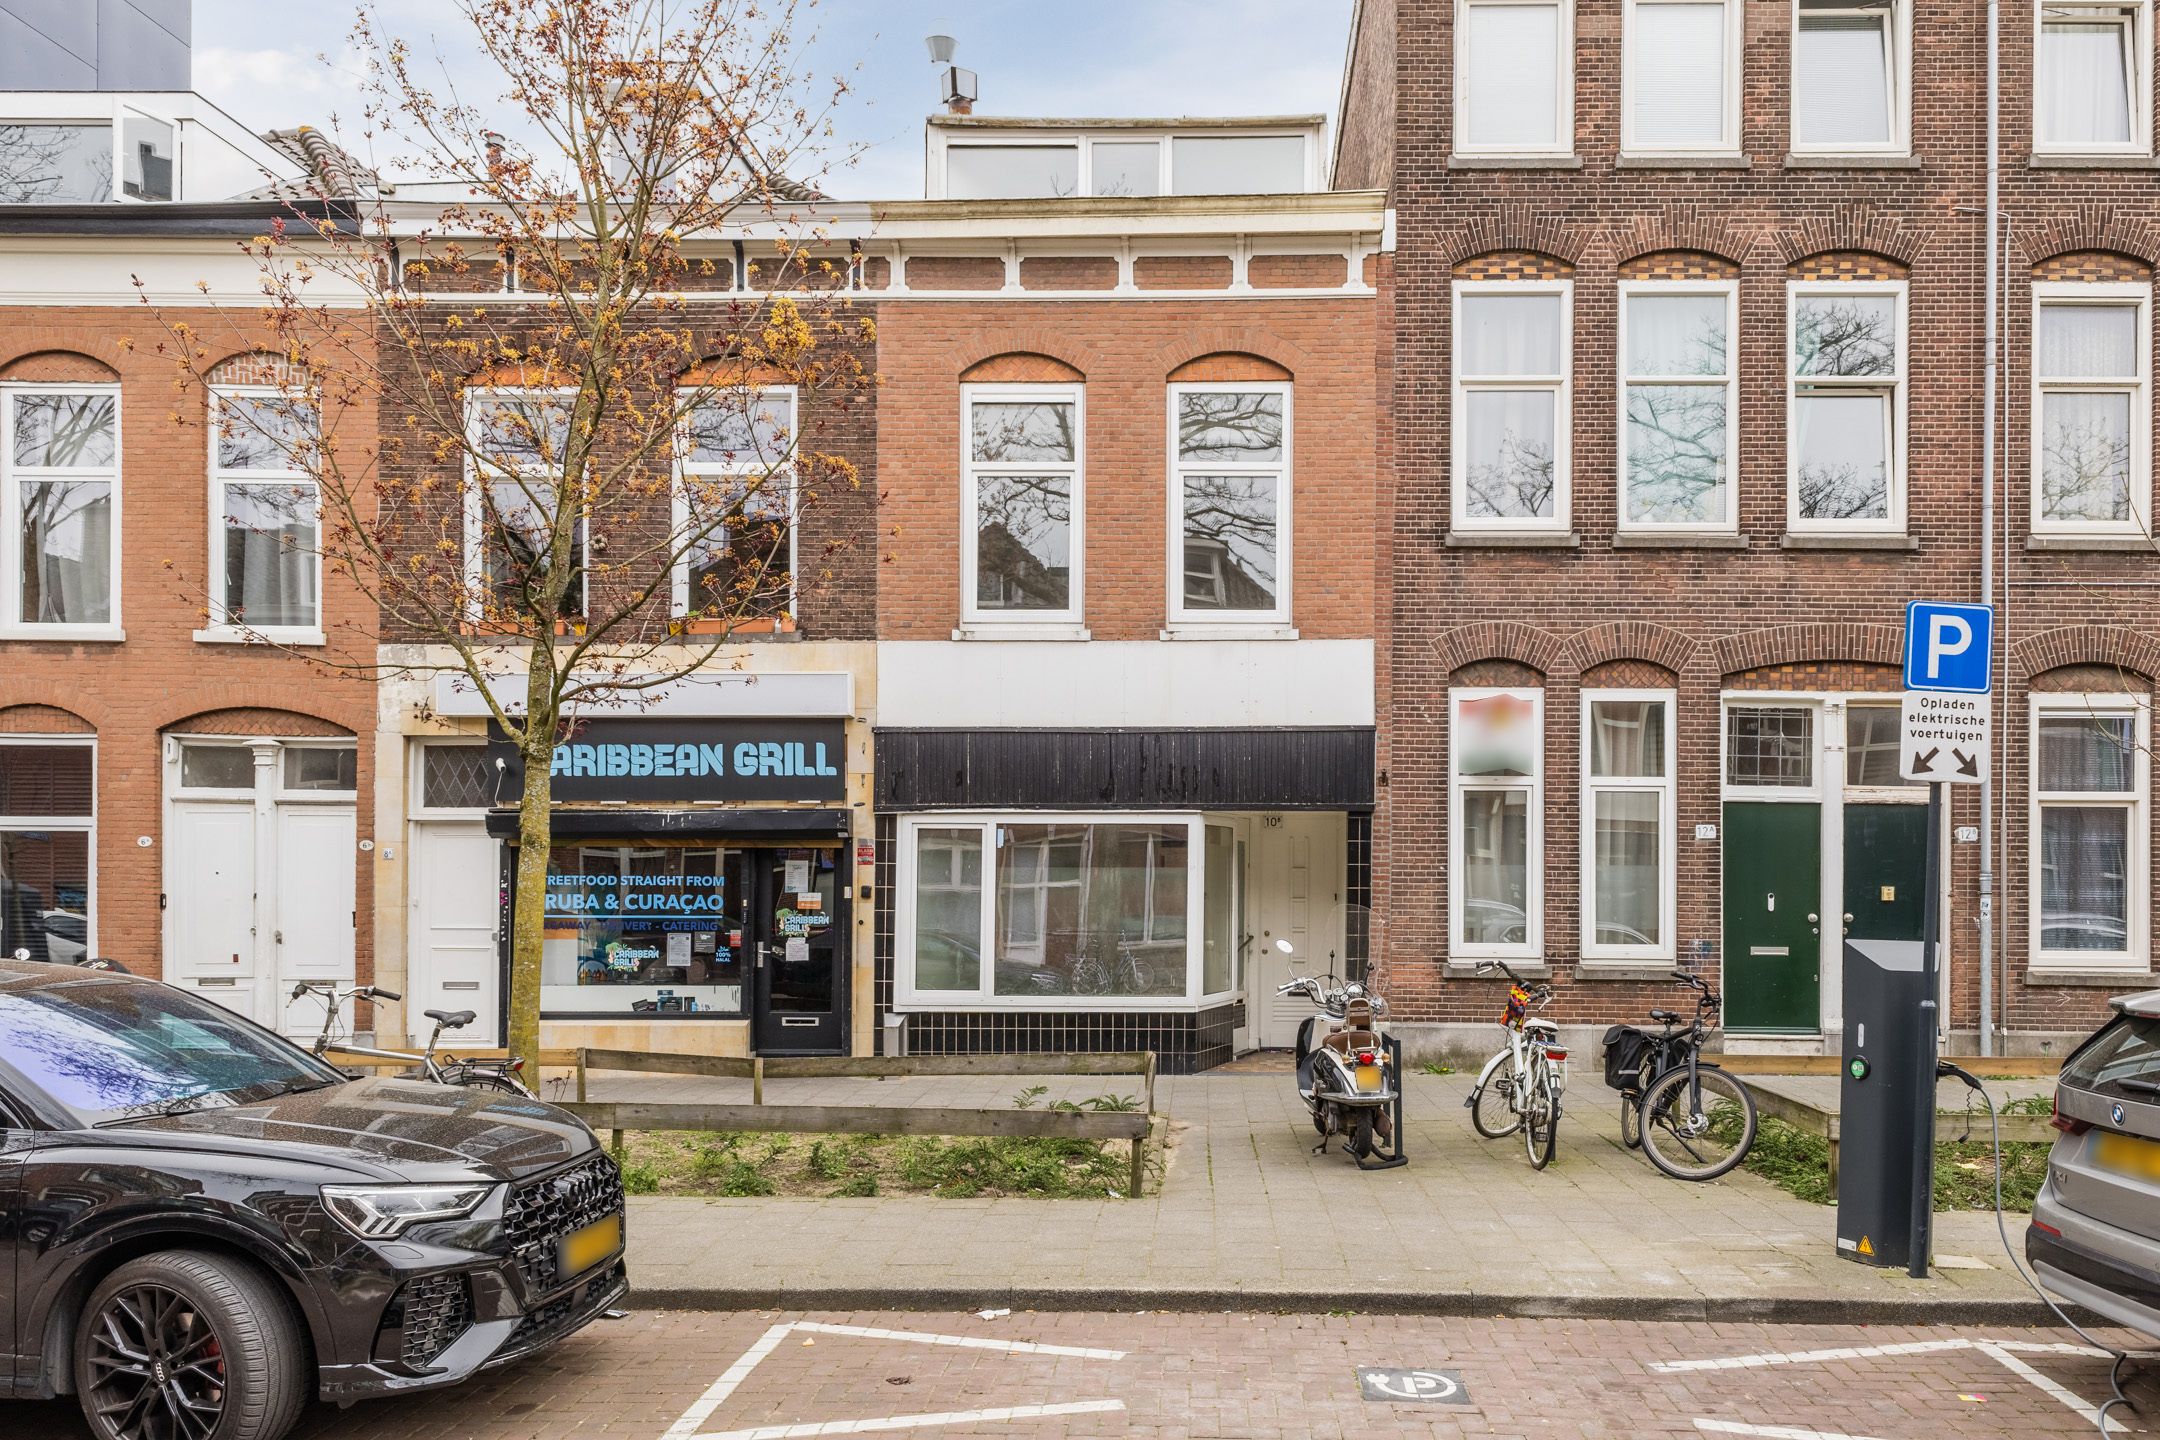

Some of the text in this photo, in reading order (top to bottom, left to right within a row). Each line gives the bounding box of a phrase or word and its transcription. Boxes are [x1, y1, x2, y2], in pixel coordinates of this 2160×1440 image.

[1927, 614, 1972, 679] P
[1920, 697, 1975, 711] Opladen
[1909, 713, 1985, 726] elektrische
[1910, 729, 1983, 743] voertuigen
[550, 742, 837, 776] ARIBBEAN GRILL
[546, 875, 725, 887] REETFOOD STRAIGHT FROM
[545, 893, 724, 914] RUBA & CURAÇAO
[662, 921, 718, 931] CATERING
[784, 915, 830, 925] CARIBBEAN
[784, 924, 807, 932] GRILL
[614, 949, 659, 959] CARIBBEAN
